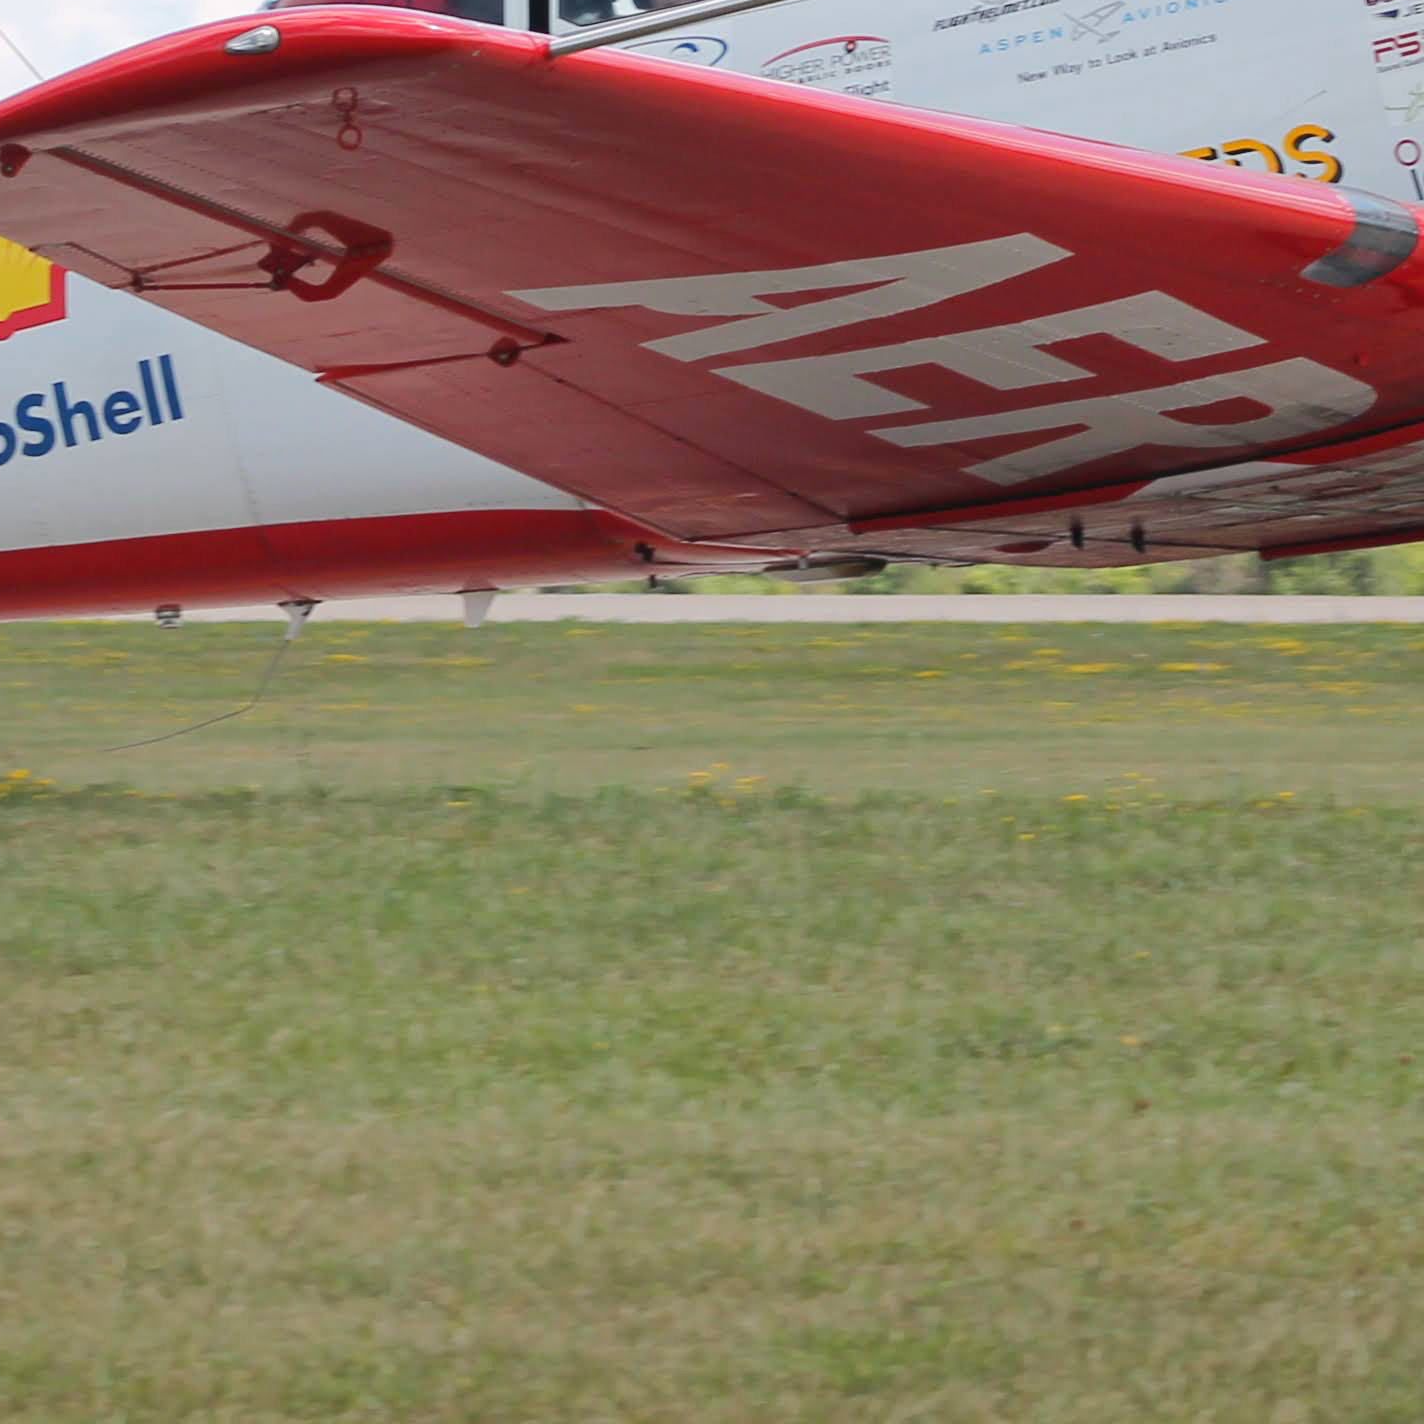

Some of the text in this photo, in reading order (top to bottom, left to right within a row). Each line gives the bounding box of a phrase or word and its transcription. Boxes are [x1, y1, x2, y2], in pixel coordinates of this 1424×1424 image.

[831, 45, 892, 66] POWER
[979, 26, 1064, 55] ASPEN
[1372, 31, 1421, 63] PS
[1176, 123, 1343, 184] DS
